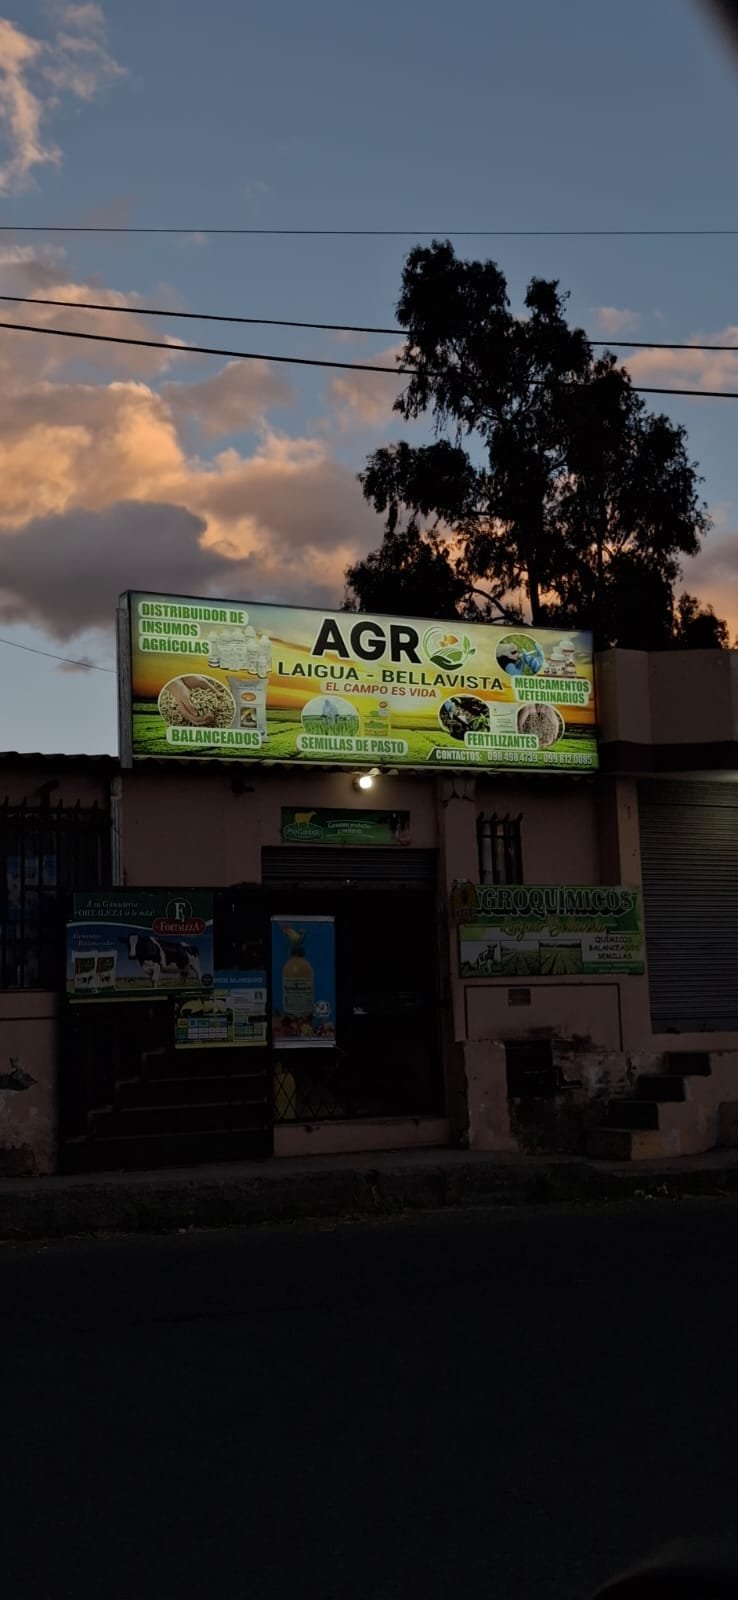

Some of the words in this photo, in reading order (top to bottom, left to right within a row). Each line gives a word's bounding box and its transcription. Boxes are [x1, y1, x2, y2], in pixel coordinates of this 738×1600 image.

[142, 603, 227, 622] DISTRIBUIDOR
[230, 610, 244, 624] DE
[142, 621, 198, 636] INSUMOS
[142, 637, 209, 654] AGRÍCOLAS
[278, 661, 359, 680] LAIGUA
[382, 669, 503, 690] BELLAVISTA
[325, 682, 340, 692] EL
[343, 683, 388, 695] CAMPO
[391, 687, 406, 696] ES
[410, 687, 437, 698] VIDA
[514, 677, 589, 692] MEDICAMENTOS
[518, 690, 585, 704] VETERINARIOS
[172, 729, 260, 745] BALANCEADOS
[301, 736, 353, 751] SEMILLAS
[356, 740, 370, 752] DE
[371, 740, 404, 753] PASTO
[467, 732, 537, 748] FERTILIZANTES
[436, 750, 482, 761] CONTACTOS:
[487, 751, 503, 761] 098
[543, 753, 558, 763] 099
[597, 952, 632, 960] SEMILLAS
